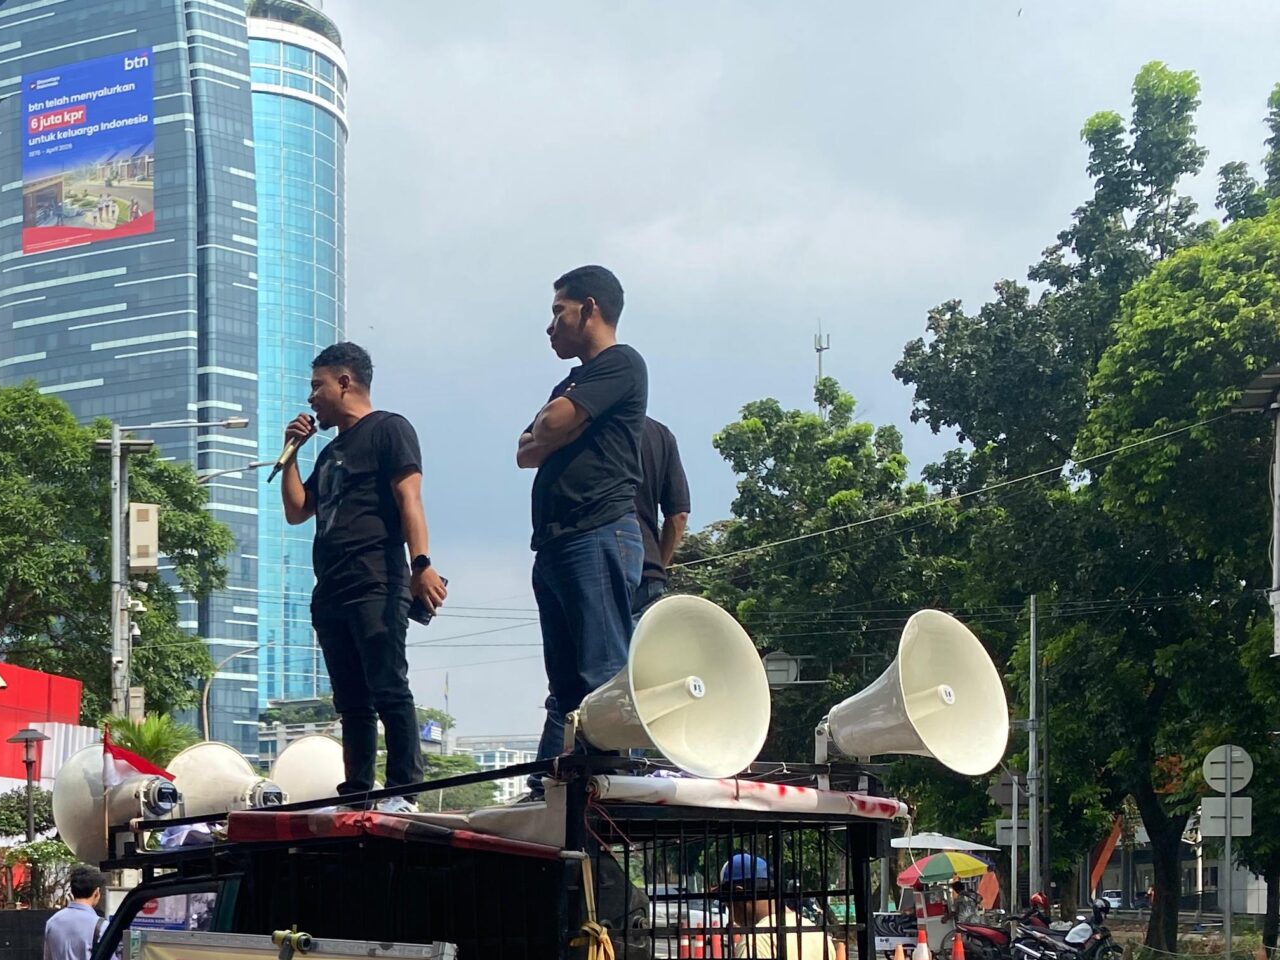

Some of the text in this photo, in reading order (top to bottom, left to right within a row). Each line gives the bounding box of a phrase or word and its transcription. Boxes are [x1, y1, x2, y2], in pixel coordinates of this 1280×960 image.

[124, 56, 148, 71] btn
[28, 83, 135, 112] btn telah menyalurkan
[28, 114, 148, 146] untuk keluarga Indonesia
[31, 109, 84, 131] 6 juta kpr
